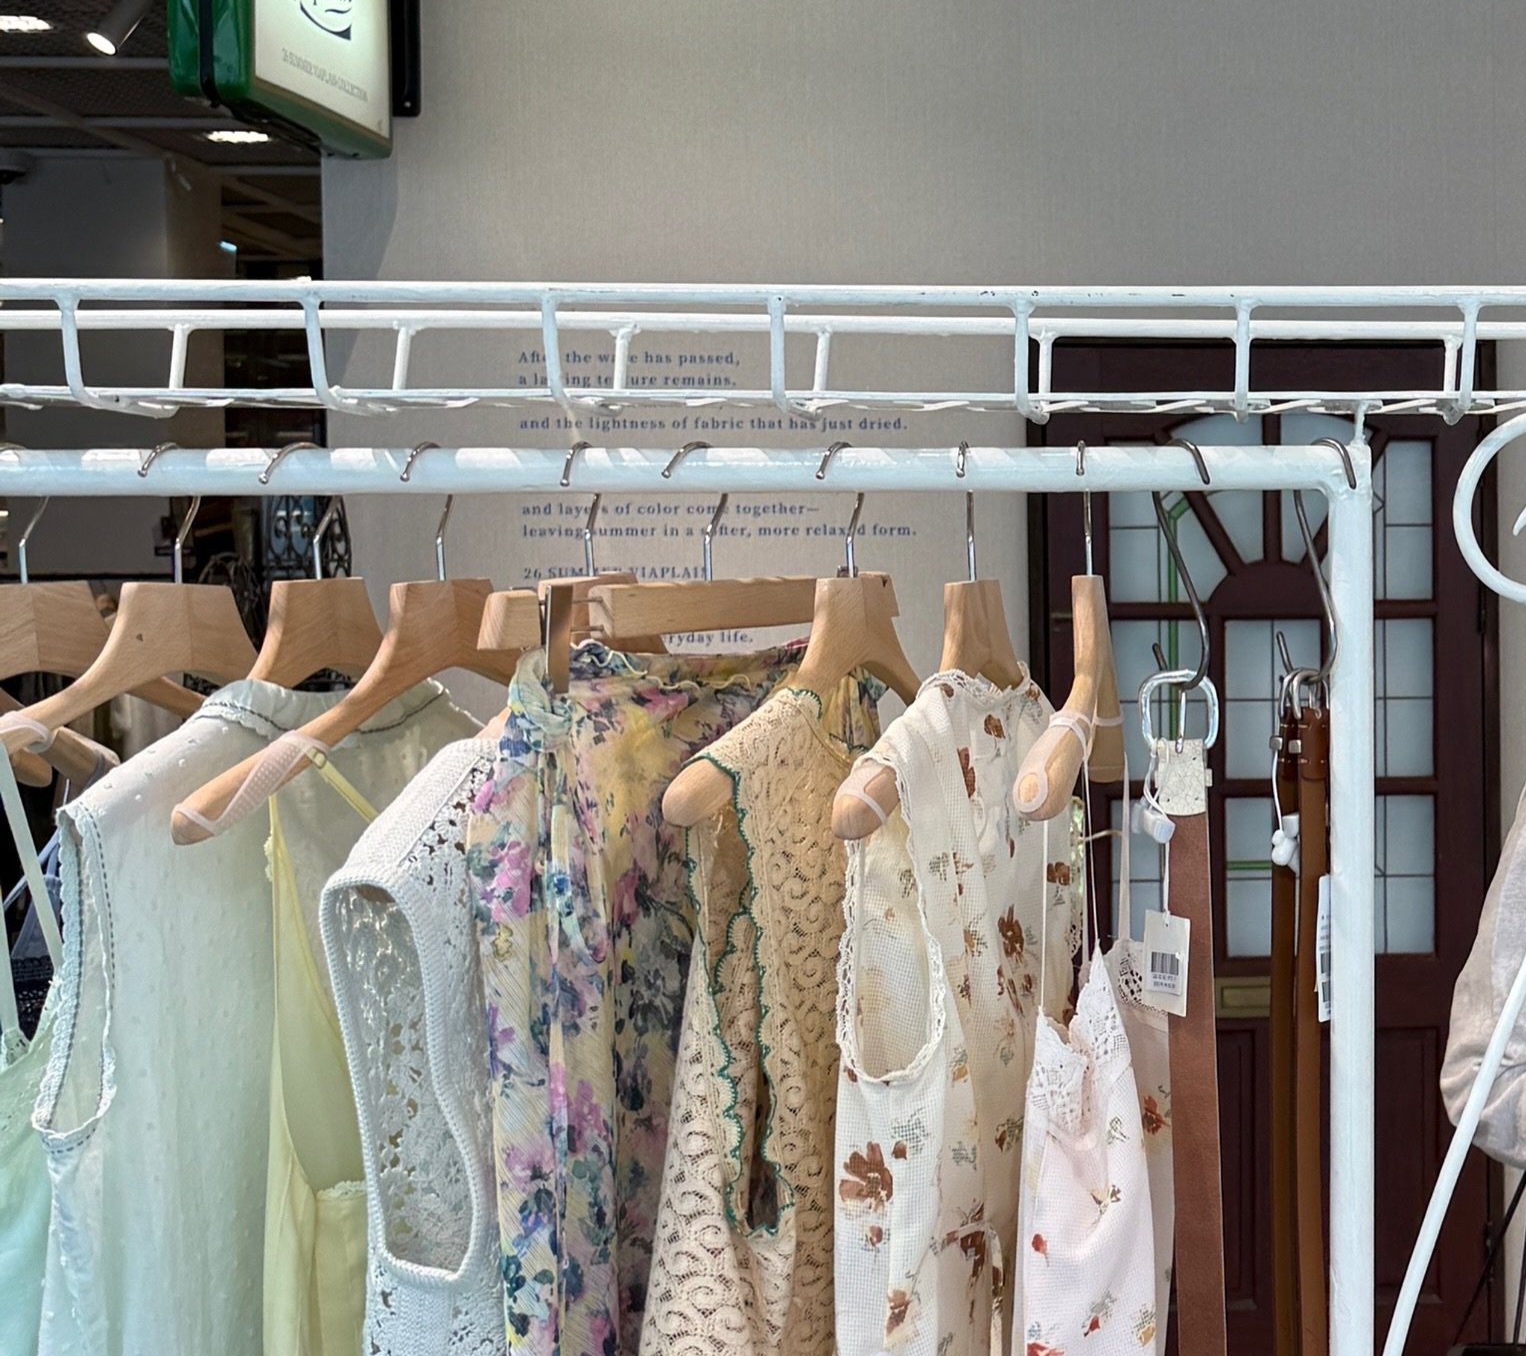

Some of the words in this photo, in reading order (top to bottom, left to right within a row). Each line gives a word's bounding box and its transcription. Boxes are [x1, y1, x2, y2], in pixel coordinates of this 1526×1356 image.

[566, 350, 592, 364] the
[598, 351, 638, 364] wae
[645, 350, 673, 364] has
[679, 351, 740, 367] passed,
[519, 375, 527, 385] a
[533, 372, 591, 388] laing
[597, 374, 657, 386] teure
[664, 373, 736, 386] remains.
[520, 417, 549, 430] and
[557, 416, 583, 430] the
[589, 416, 666, 433] lightness
[672, 417, 688, 430] of
[694, 417, 744, 430] fabric
[751, 417, 782, 430] that
[789, 417, 816, 430] has
[821, 417, 852, 433] just
[859, 417, 907, 430] dried.
[522, 502, 551, 515] and
[559, 502, 608, 519] layes
[615, 502, 632, 515] of
[637, 502, 680, 515] color
[523, 524, 584, 539] leaving
[664, 524, 679, 536] in
[686, 527, 693, 536] a
[701, 524, 751, 538] sfter,
[758, 527, 799, 537] more
[806, 524, 866, 536] relaxd
[873, 524, 916, 536] form.
[524, 567, 541, 579] 26
[629, 566, 706, 579] VIAPLAI
[720, 629, 753, 643] life.
